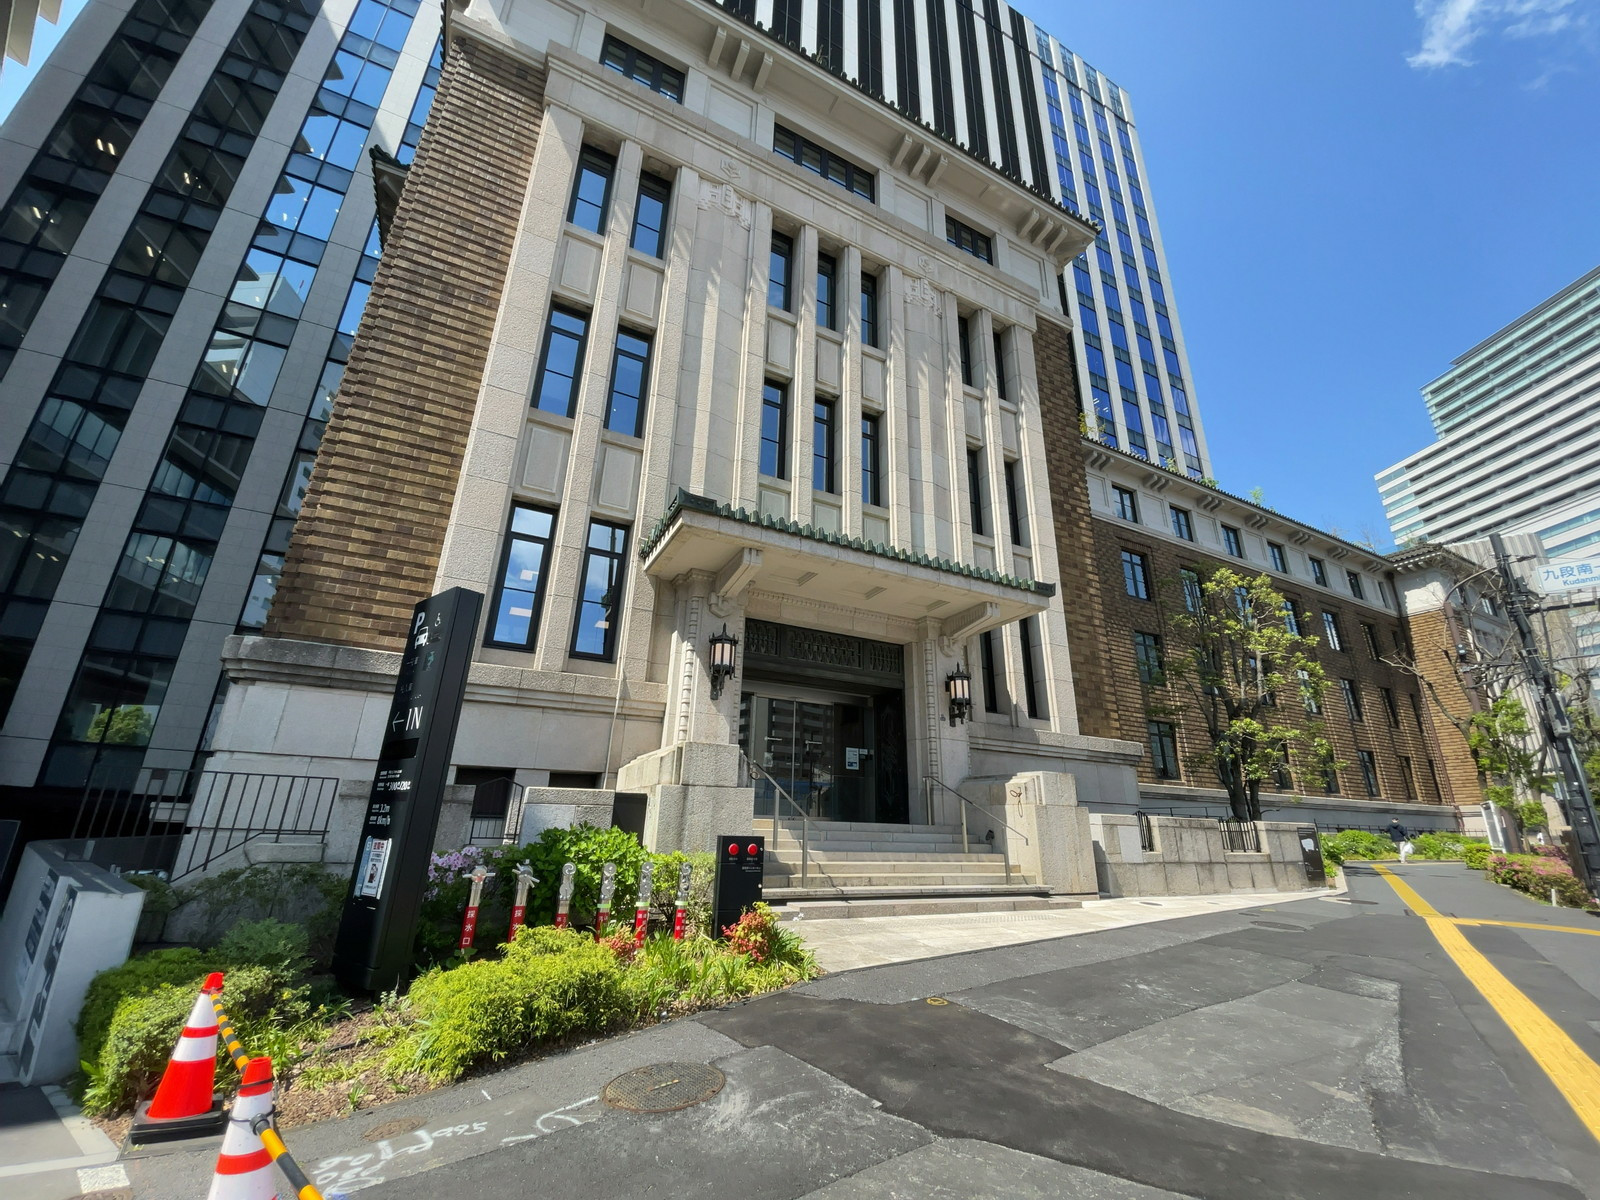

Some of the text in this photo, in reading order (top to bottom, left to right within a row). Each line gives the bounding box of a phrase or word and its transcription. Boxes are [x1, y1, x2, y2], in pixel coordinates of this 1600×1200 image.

[414, 611, 425, 635] P
[405, 706, 424, 731] IN
[462, 909, 476, 945] 採水口
